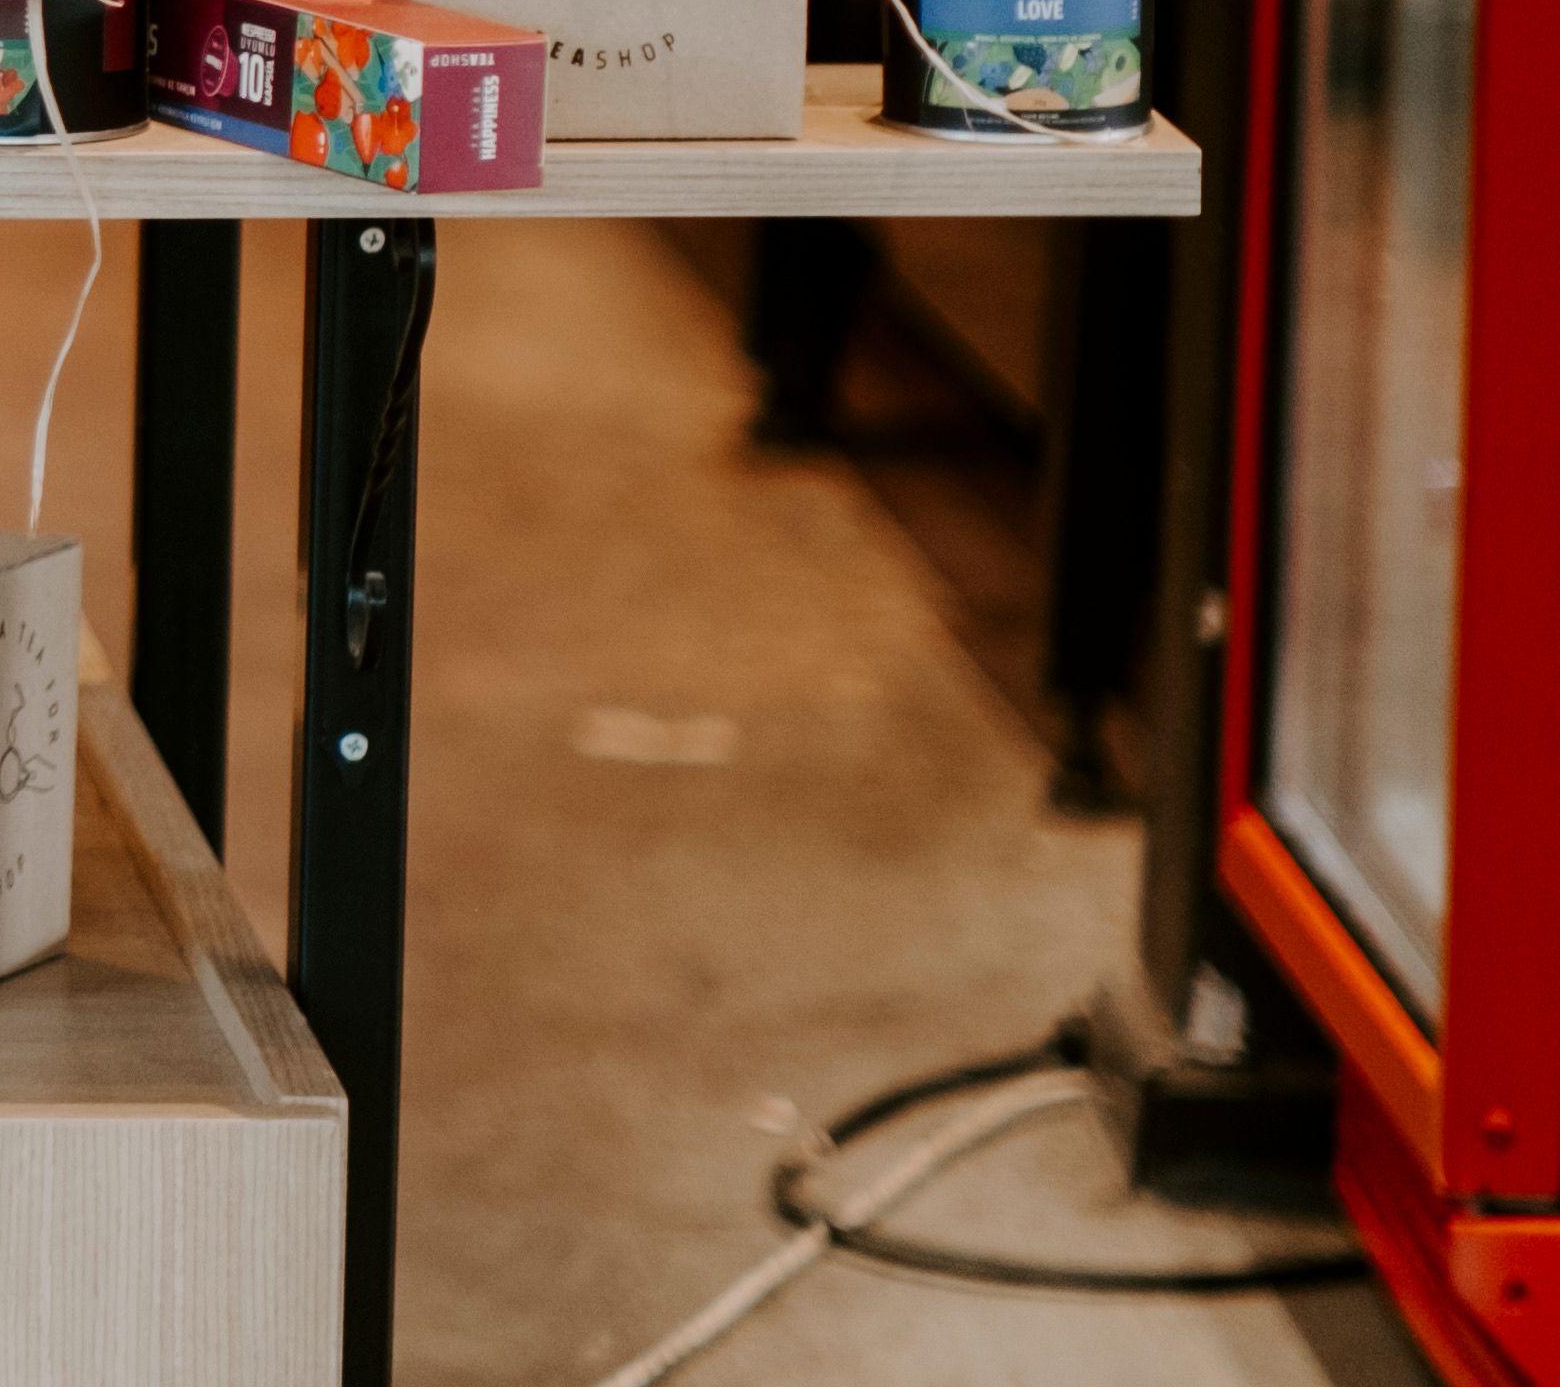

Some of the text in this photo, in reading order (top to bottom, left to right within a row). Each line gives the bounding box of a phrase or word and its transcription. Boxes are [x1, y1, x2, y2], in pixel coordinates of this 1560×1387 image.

[239, 35, 276, 59] UYUMLU
[240, 21, 277, 44] NESPRESSO
[430, 50, 496, 68] TEASHOP
[549, 31, 677, 69] EASHOP
[238, 51, 265, 104] 10
[480, 73, 501, 161] HAPPINESS
